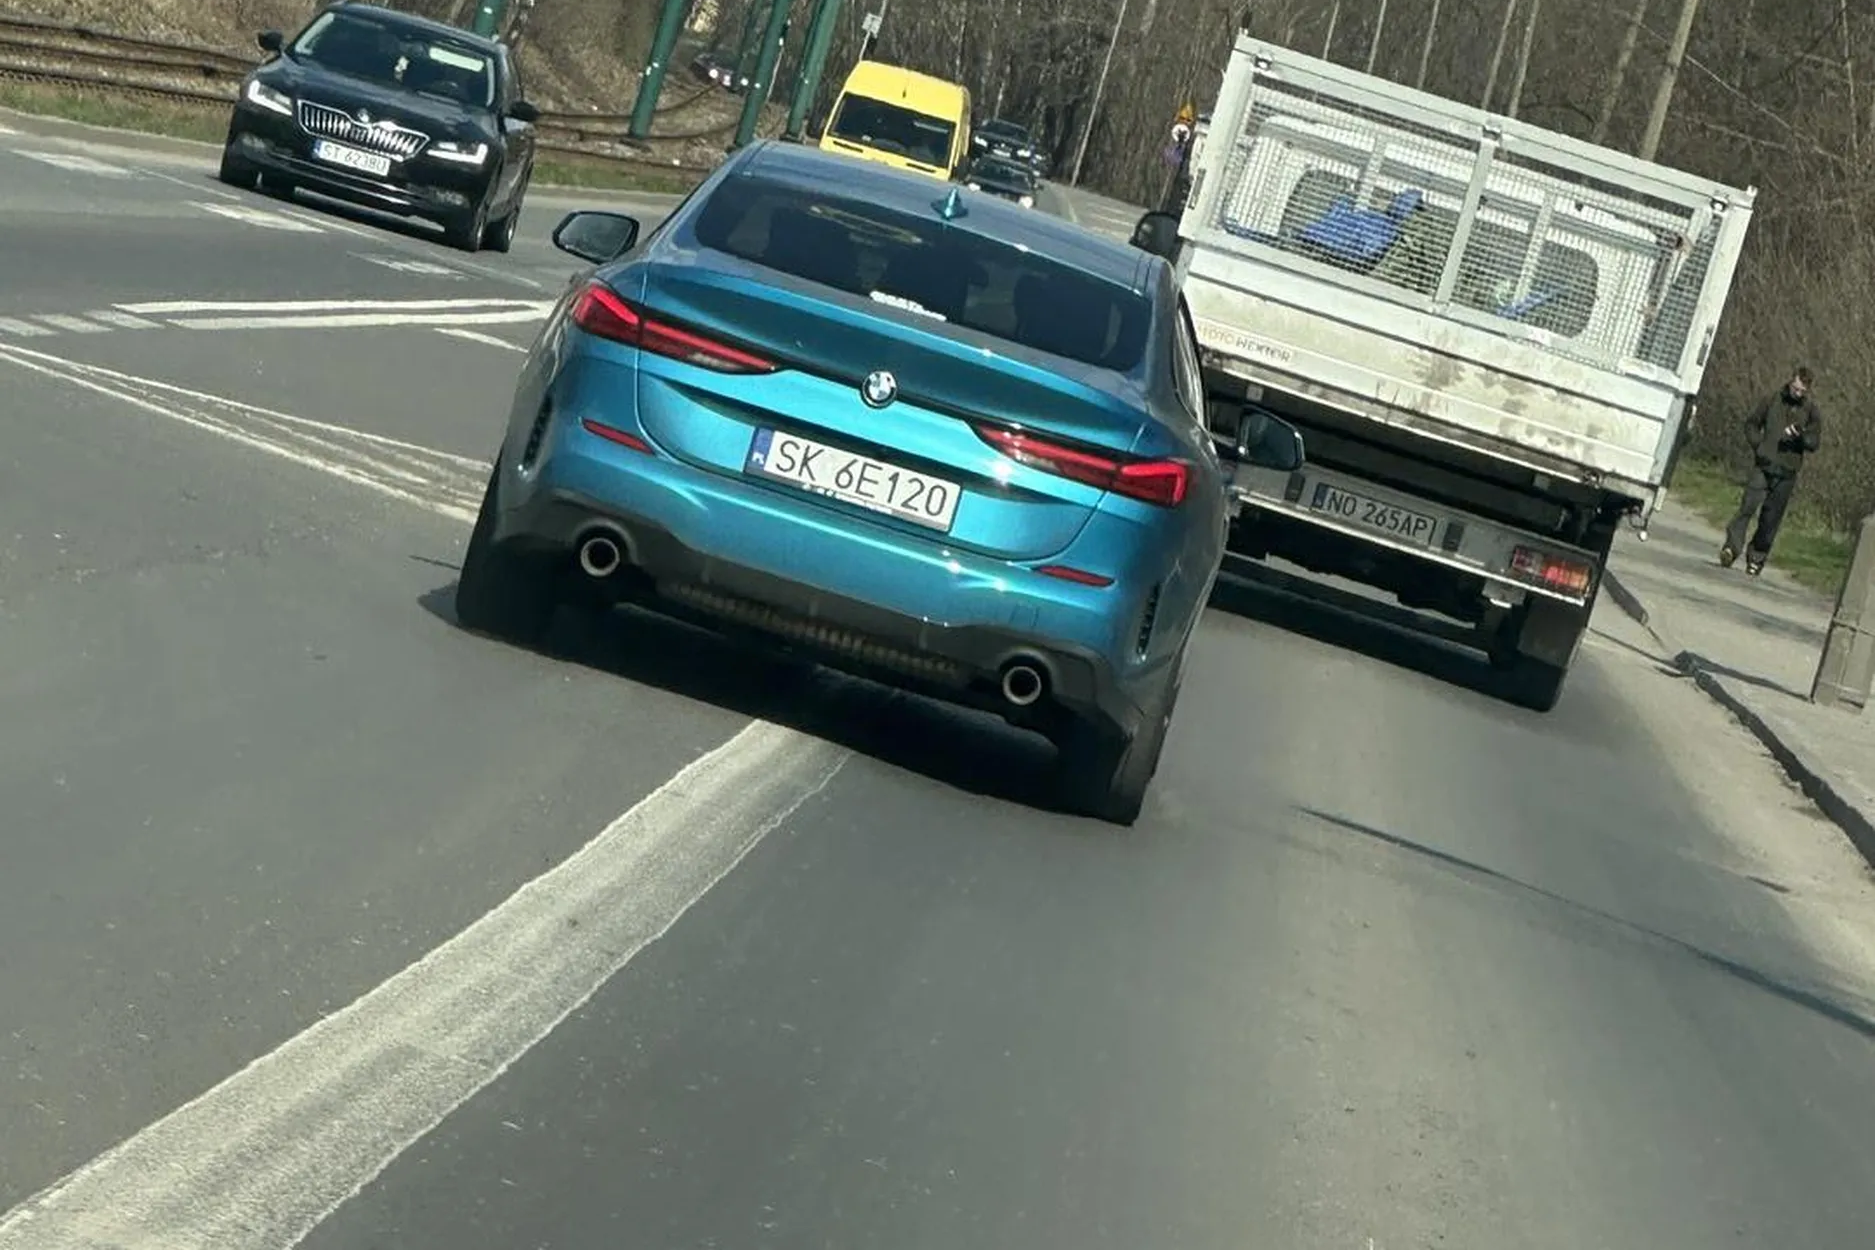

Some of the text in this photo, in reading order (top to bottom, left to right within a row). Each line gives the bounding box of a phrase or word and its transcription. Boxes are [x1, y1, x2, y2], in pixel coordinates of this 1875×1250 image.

[323, 144, 341, 159] ST
[775, 440, 825, 482] SK
[834, 458, 948, 517] 6E120
[1361, 503, 1428, 538] 265AP
